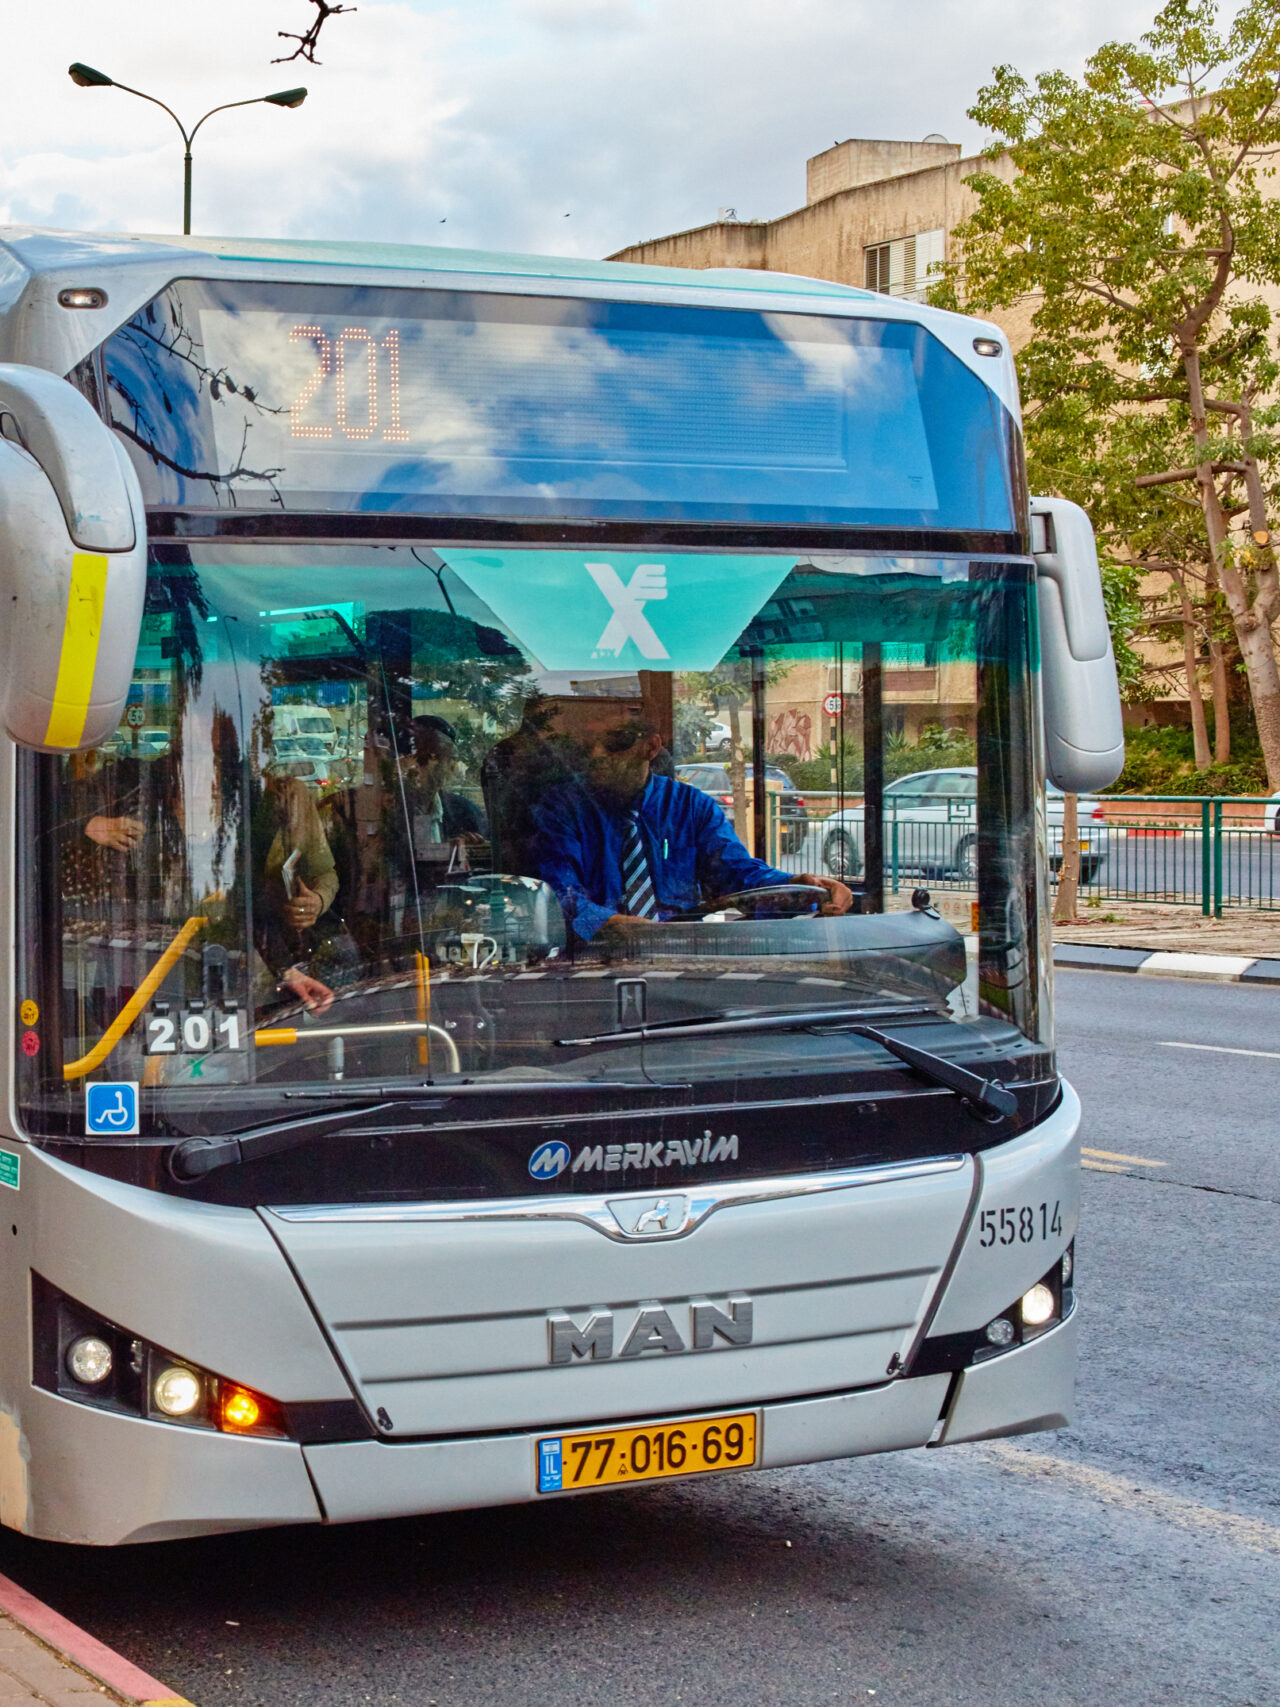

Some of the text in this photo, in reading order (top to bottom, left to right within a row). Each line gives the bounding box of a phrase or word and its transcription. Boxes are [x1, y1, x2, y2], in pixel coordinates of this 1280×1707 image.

[289, 325, 410, 441] 201
[149, 1015, 240, 1052] 201
[980, 1200, 1062, 1248] 55814
[547, 1297, 754, 1364] MAN
[545, 1455, 558, 1474] IL
